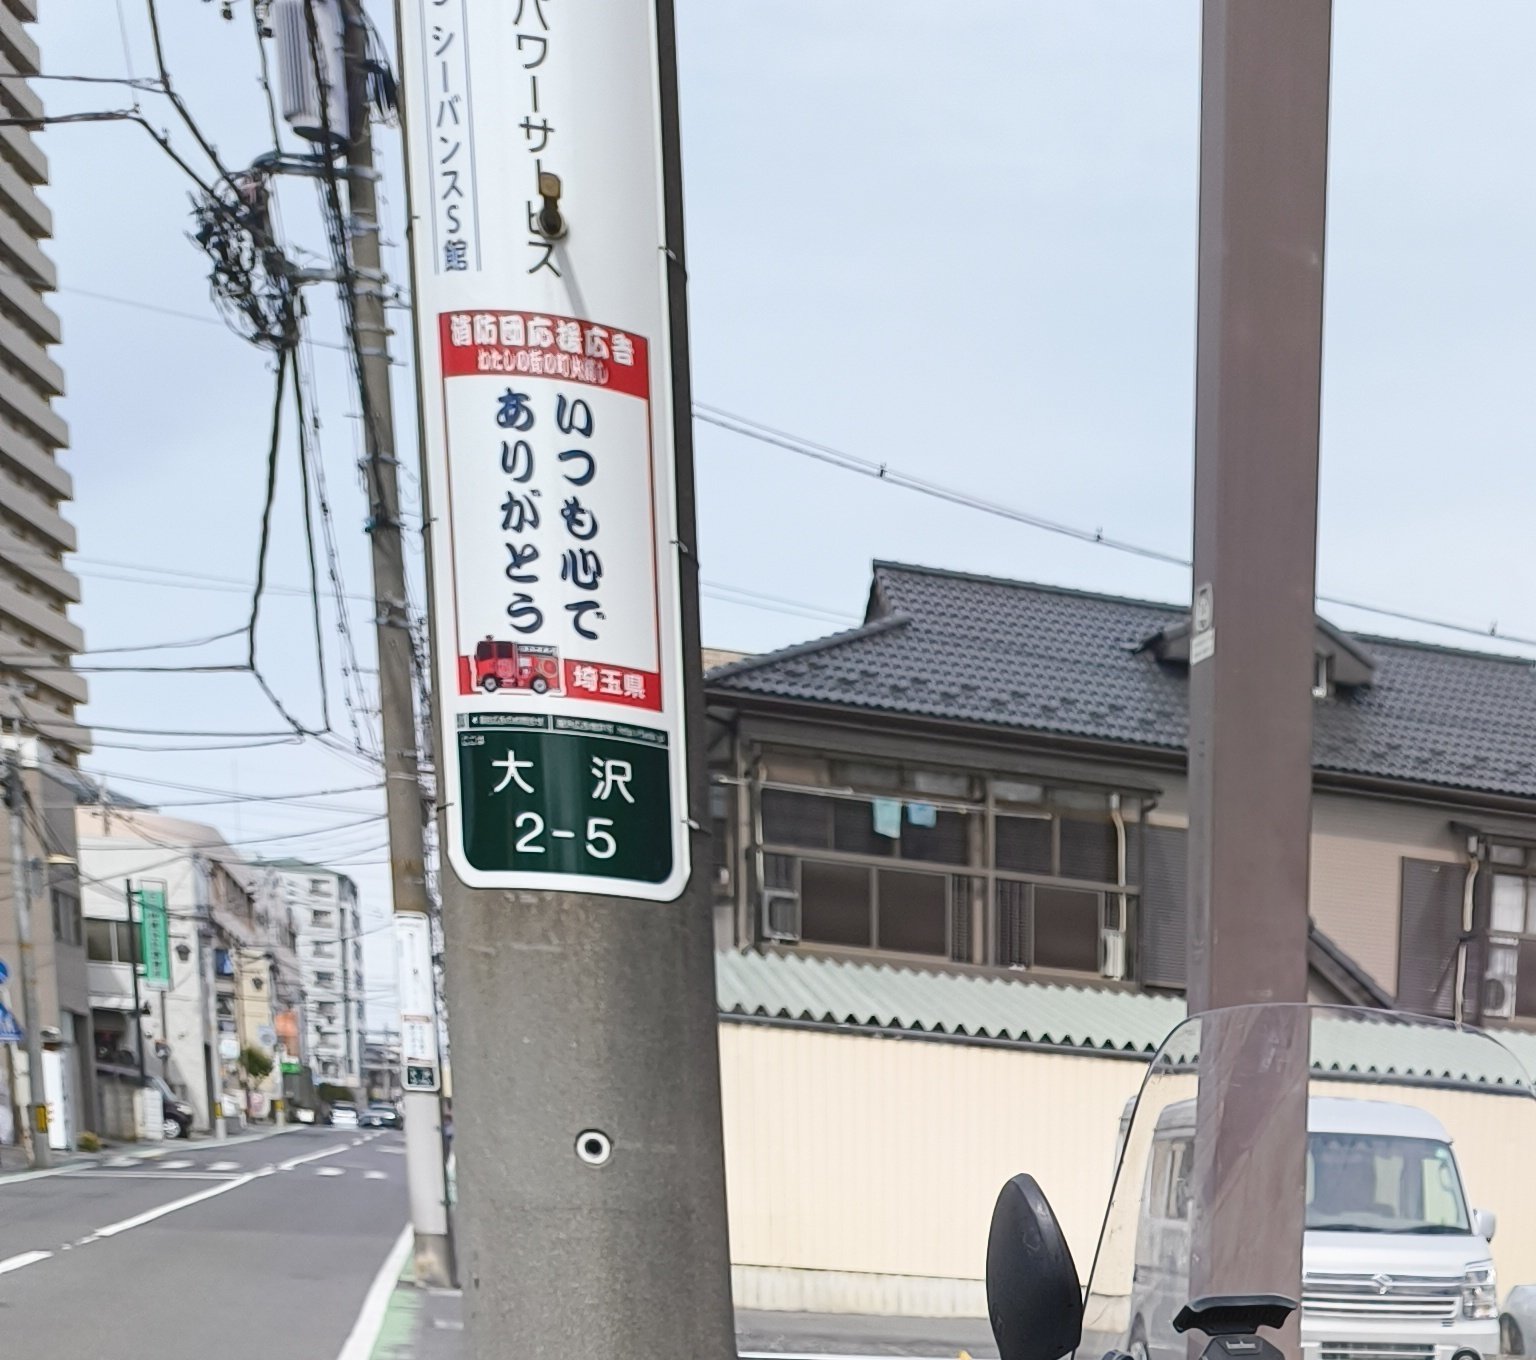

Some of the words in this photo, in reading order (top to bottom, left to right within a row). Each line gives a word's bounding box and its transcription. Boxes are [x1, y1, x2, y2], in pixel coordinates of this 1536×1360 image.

[432, 0, 468, 272] シーバンスS館
[450, 313, 635, 367] 消防団応援広告
[495, 387, 544, 635] ありがとう
[556, 392, 607, 640] いつも心で
[572, 664, 647, 700] 埼玉県
[489, 750, 635, 804] 大沢
[515, 811, 617, 860] 2-5
